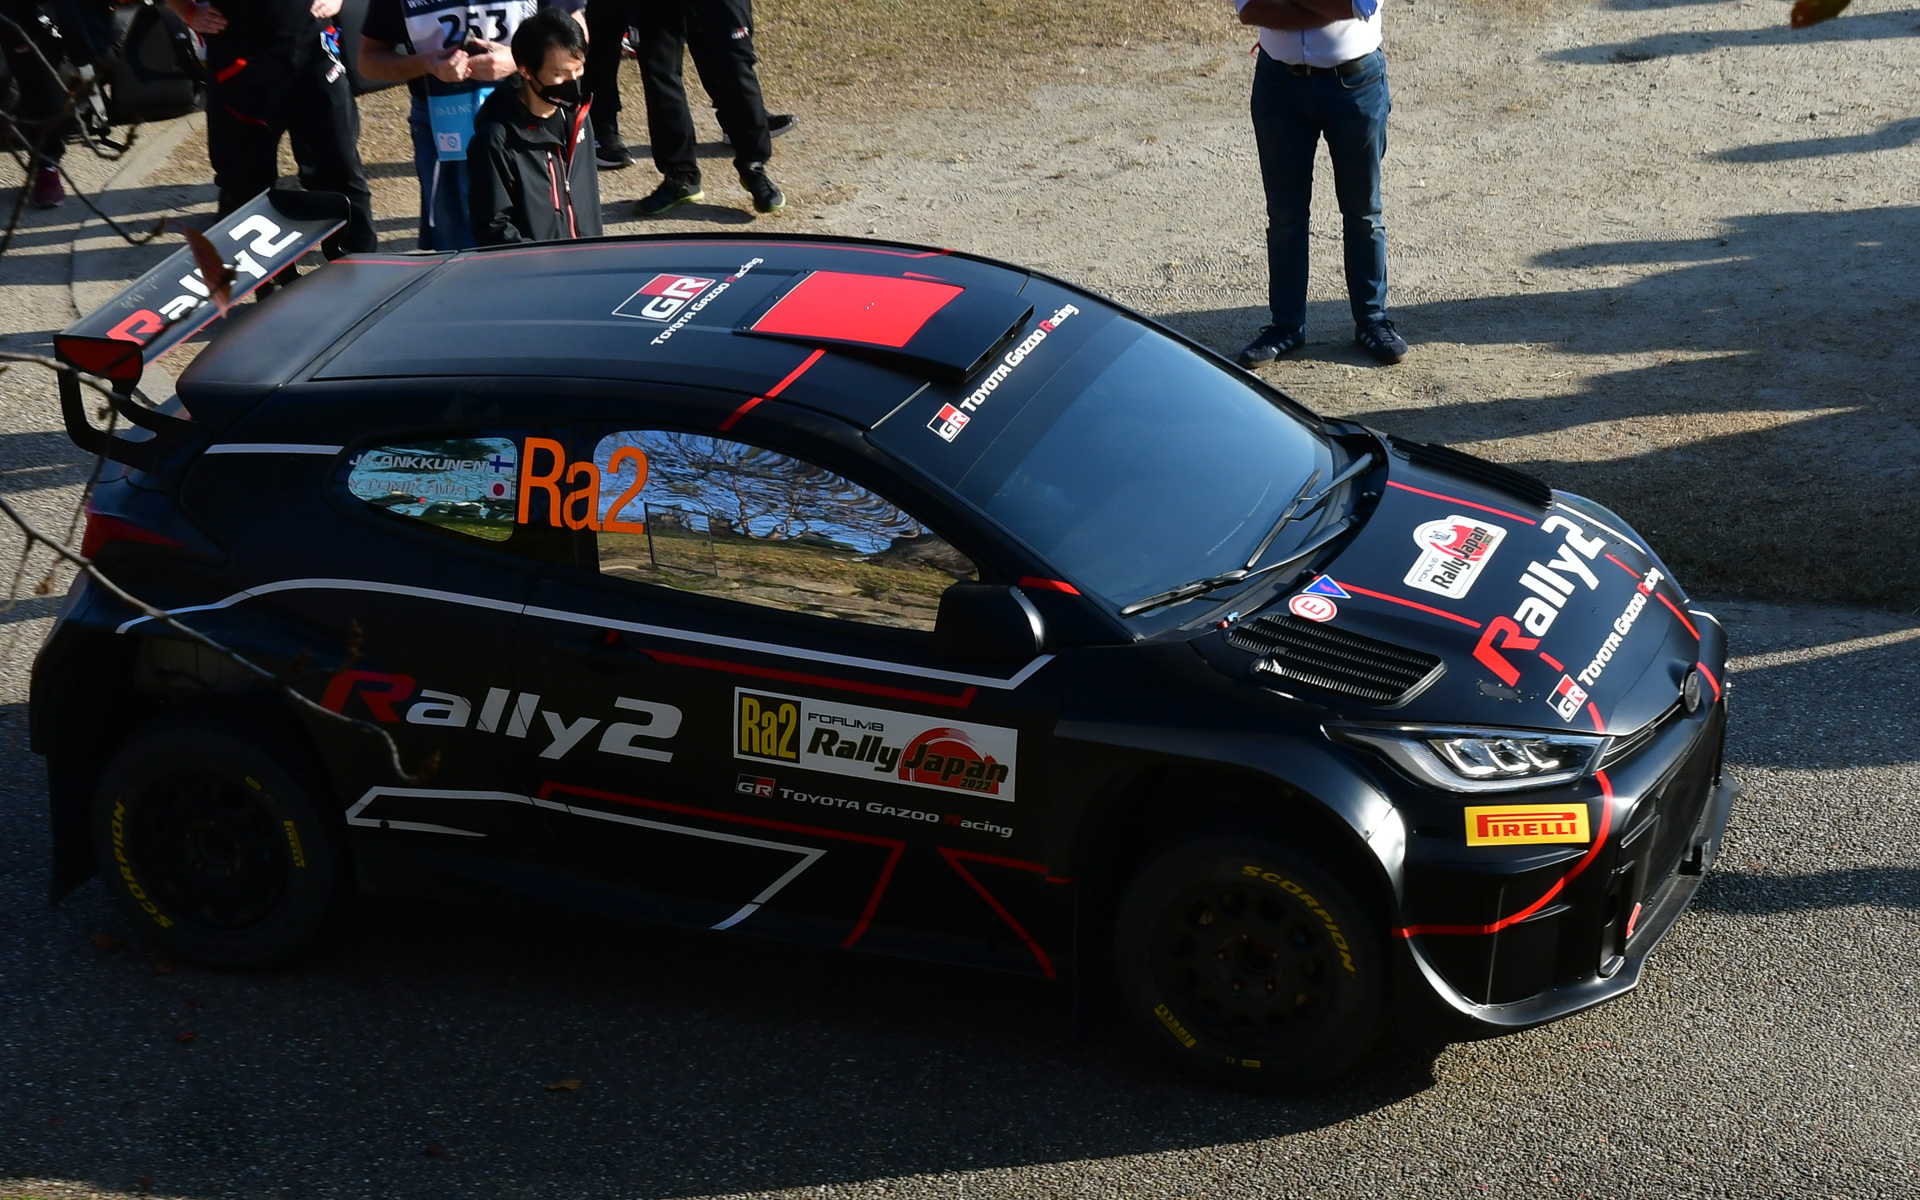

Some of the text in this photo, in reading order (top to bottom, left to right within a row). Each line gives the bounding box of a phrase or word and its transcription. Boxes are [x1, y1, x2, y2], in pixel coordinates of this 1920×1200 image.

[438, 9, 508, 49] 253
[106, 214, 303, 346] Raly2
[641, 277, 710, 319] GR
[650, 257, 764, 345] TOYOTA GAZOO Racing
[938, 303, 1080, 440] GR TOYOTA GAZOO Racing
[517, 436, 648, 534] Ra2
[1430, 556, 1472, 590] Rally
[1452, 526, 1488, 560] Japan
[1300, 600, 1326, 615] E
[1472, 515, 1607, 688] Rally2
[1558, 567, 1665, 718] GR TOYOTA GAZOO Racing
[317, 669, 683, 763] Rally2
[741, 696, 797, 760] Ra2
[807, 712, 884, 732] FORUM8
[807, 727, 1009, 783] Rally Japan
[959, 777, 992, 792] 2022
[737, 781, 1014, 839] GR TOYOTA GAZOO Racing
[1476, 812, 1577, 838] PIRELLI
[111, 800, 174, 928] SCORPION
[1240, 864, 1357, 974] SCORPION
